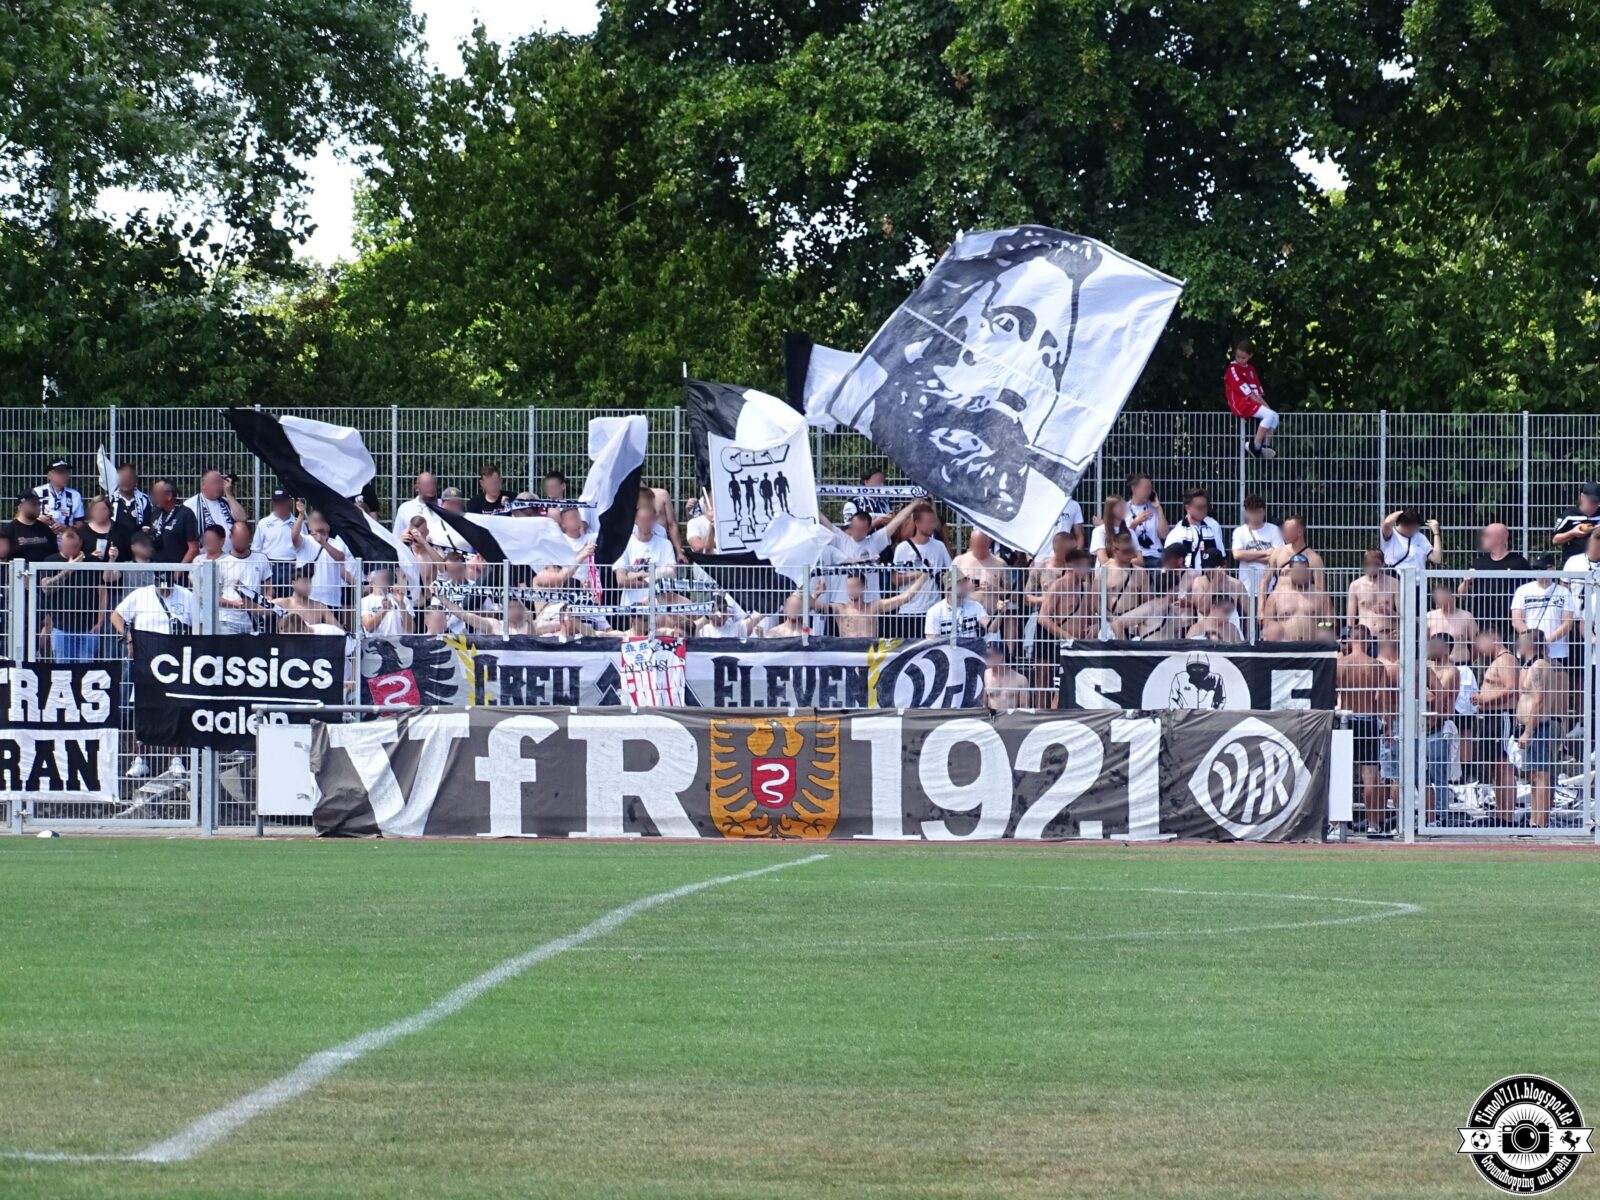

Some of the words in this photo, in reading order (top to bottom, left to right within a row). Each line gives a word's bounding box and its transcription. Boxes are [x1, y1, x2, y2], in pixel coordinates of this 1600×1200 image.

[150, 646, 333, 689] classics
[473, 654, 582, 706] CREW
[710, 655, 869, 708] ELEVEN
[0, 667, 111, 723] RAS
[329, 714, 701, 838] VfR
[851, 716, 1178, 841] 1921
